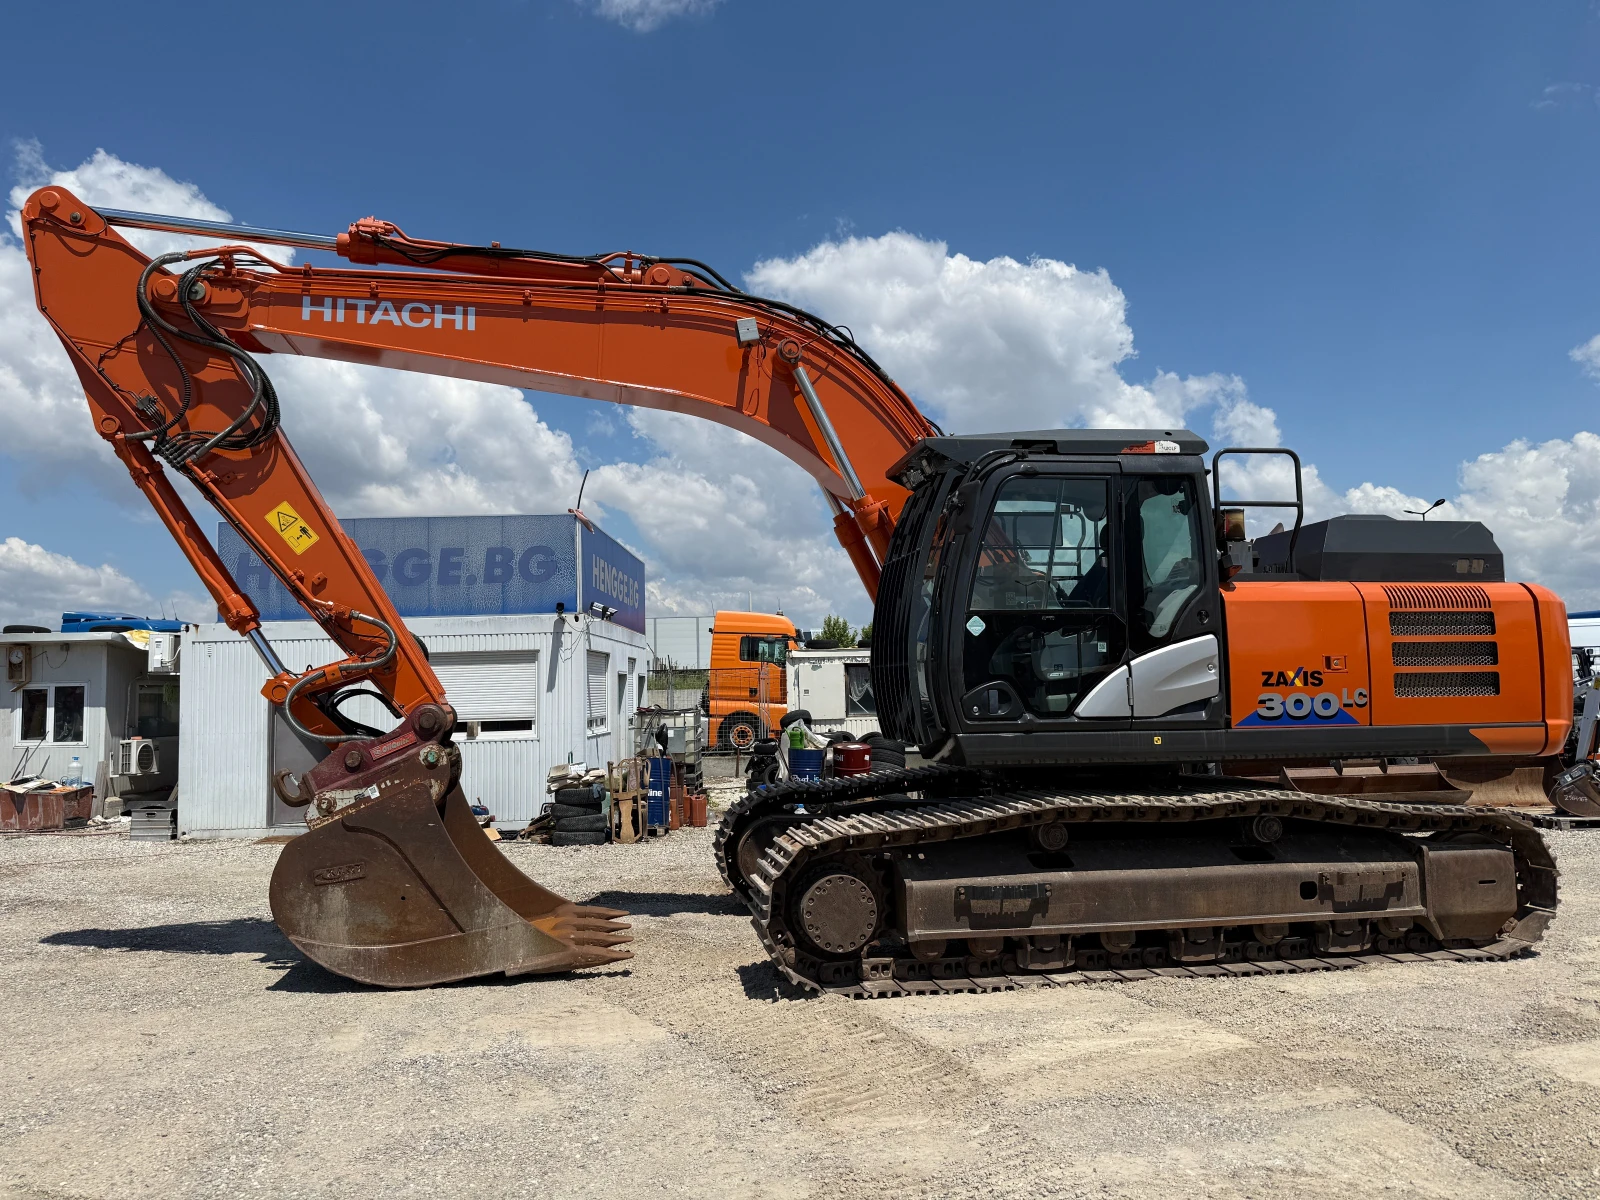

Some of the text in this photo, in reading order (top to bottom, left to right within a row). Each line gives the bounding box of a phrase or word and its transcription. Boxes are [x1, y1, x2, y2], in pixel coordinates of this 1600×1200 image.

[302, 296, 476, 331] HITACHI
[592, 553, 639, 609] HENGGE.BG
[1261, 666, 1324, 688] ZAXIS
